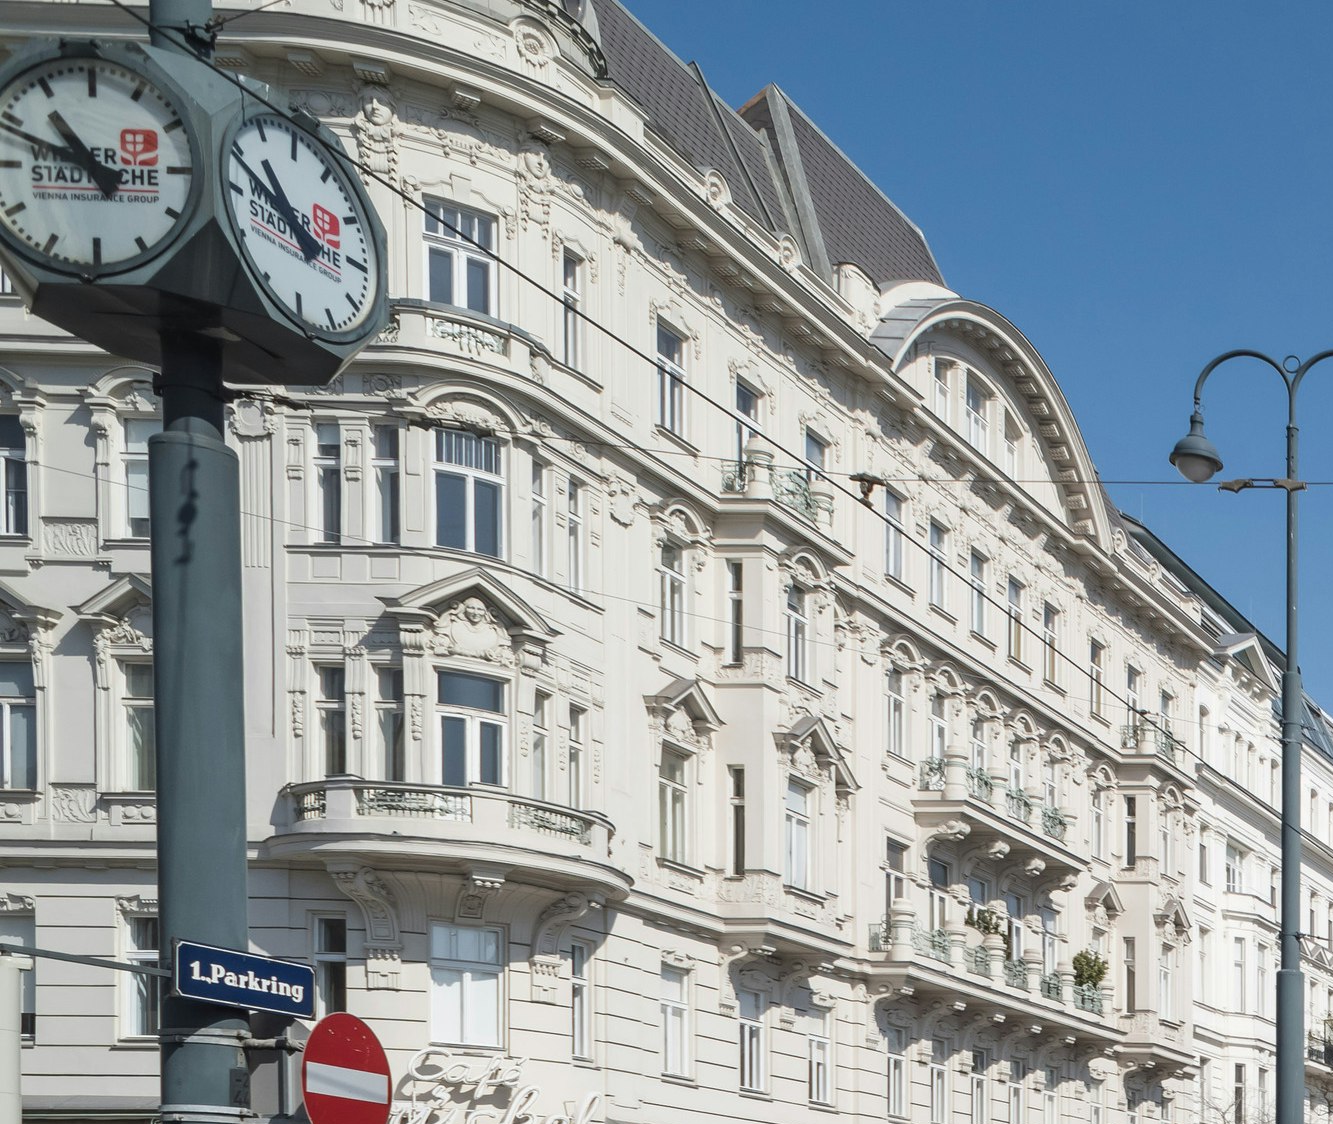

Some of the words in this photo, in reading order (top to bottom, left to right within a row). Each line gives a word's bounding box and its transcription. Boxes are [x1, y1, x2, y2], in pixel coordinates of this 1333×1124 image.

[32, 191, 69, 201] VIENNA
[127, 195, 160, 204] GROUP
[250, 223, 277, 247] VIENNA
[318, 265, 342, 283] GROUP
[407, 1047, 530, 1099] Café
